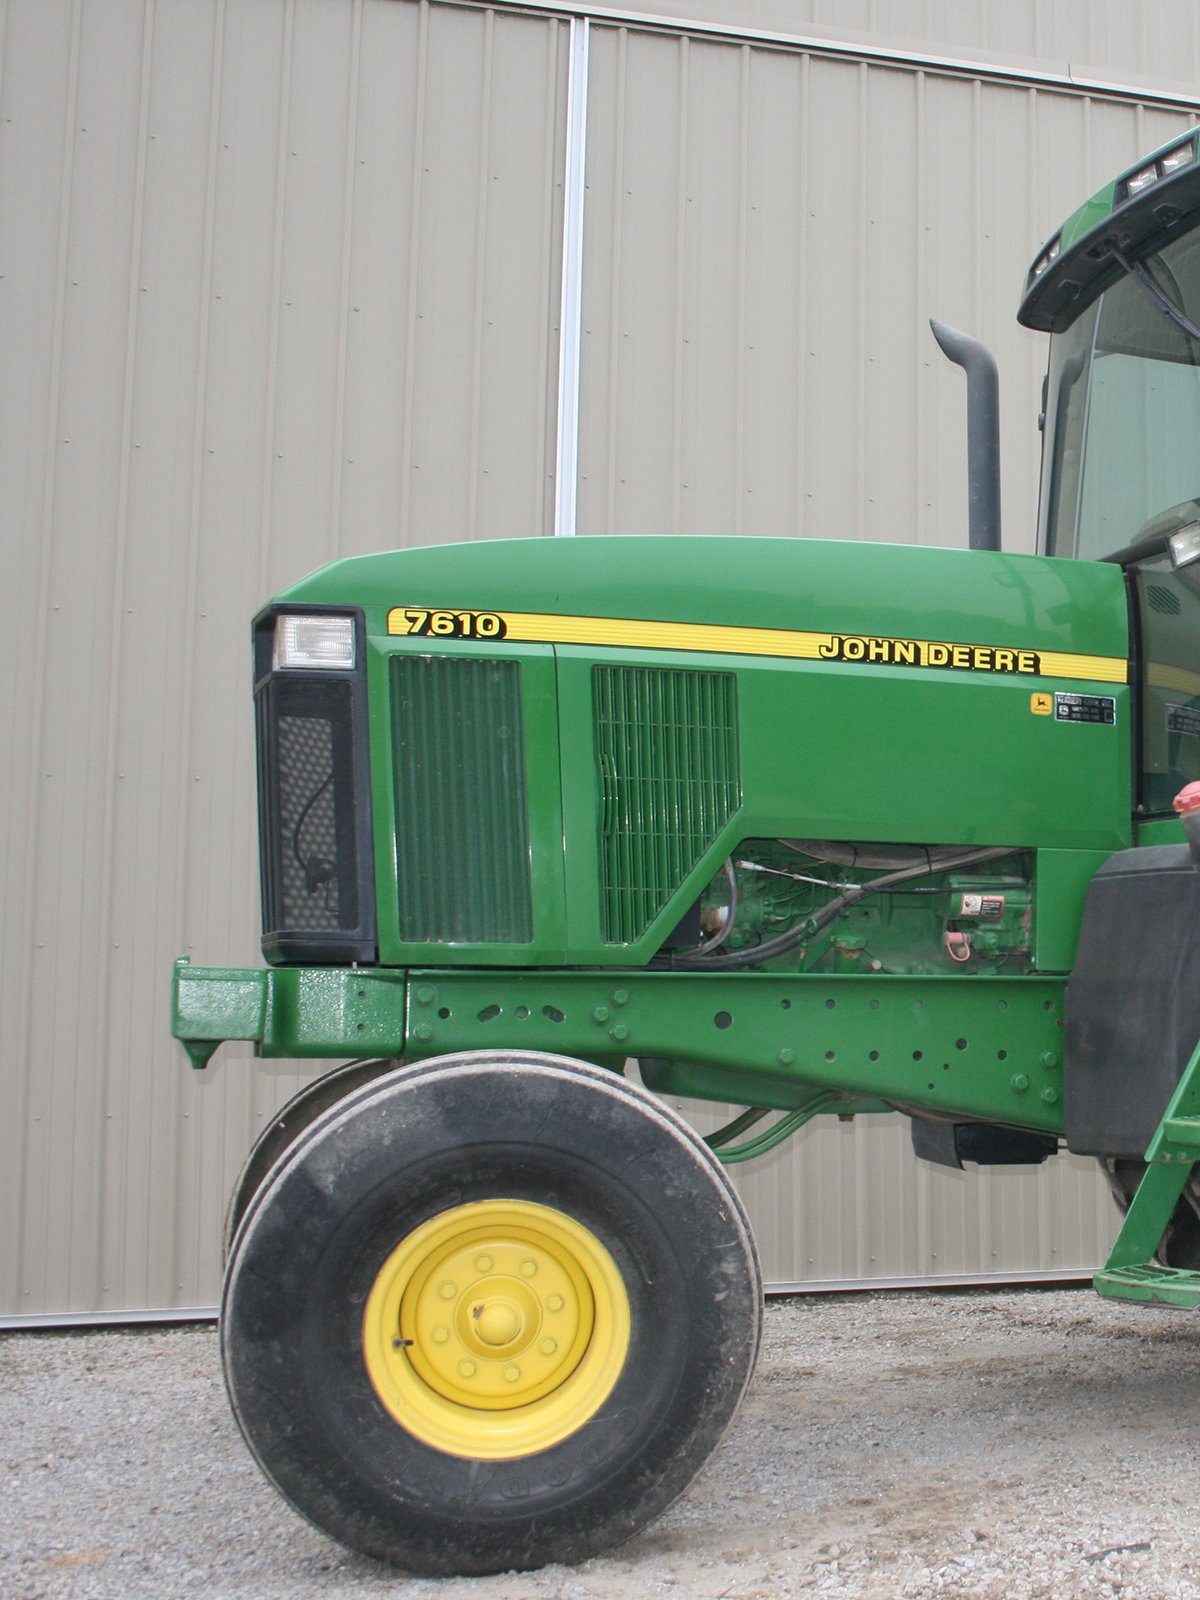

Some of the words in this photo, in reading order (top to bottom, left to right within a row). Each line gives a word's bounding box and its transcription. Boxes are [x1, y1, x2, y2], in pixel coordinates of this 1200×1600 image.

[404, 609, 507, 639] 7610
[819, 636, 921, 665] JOHN
[927, 643, 1040, 675] DEERE
